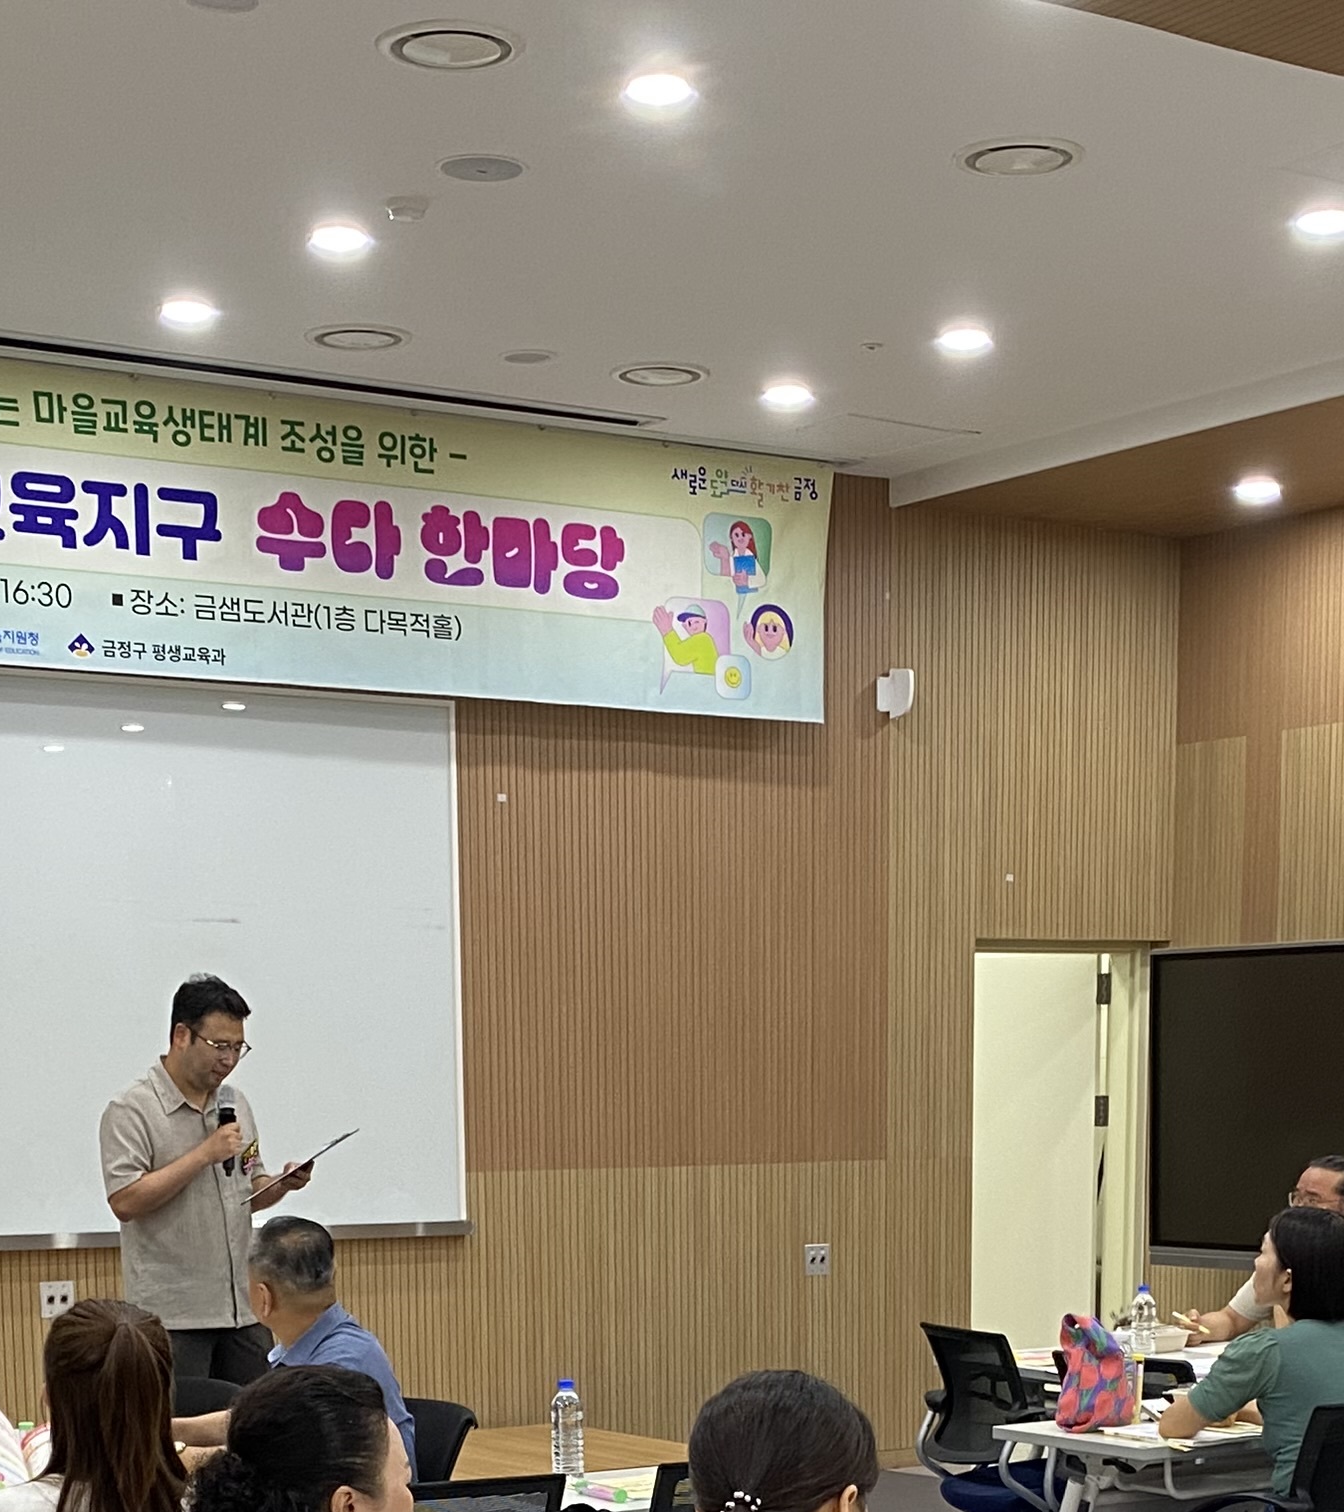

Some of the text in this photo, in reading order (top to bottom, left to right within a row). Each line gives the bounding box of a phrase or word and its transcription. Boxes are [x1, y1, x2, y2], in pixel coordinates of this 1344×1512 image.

[32, 390, 268, 447] 마을교육생태계
[279, 418, 365, 467] 조성을
[376, 431, 438, 475] 위한
[671, 466, 706, 496] 새로운
[793, 477, 819, 501] 금정
[255, 490, 402, 580] 수다
[420, 504, 625, 600] 한마당
[129, 588, 463, 641] 장소: 금샘도서관(1층 다목적홀)
[101, 639, 227, 666] 금정구 평생교육과
